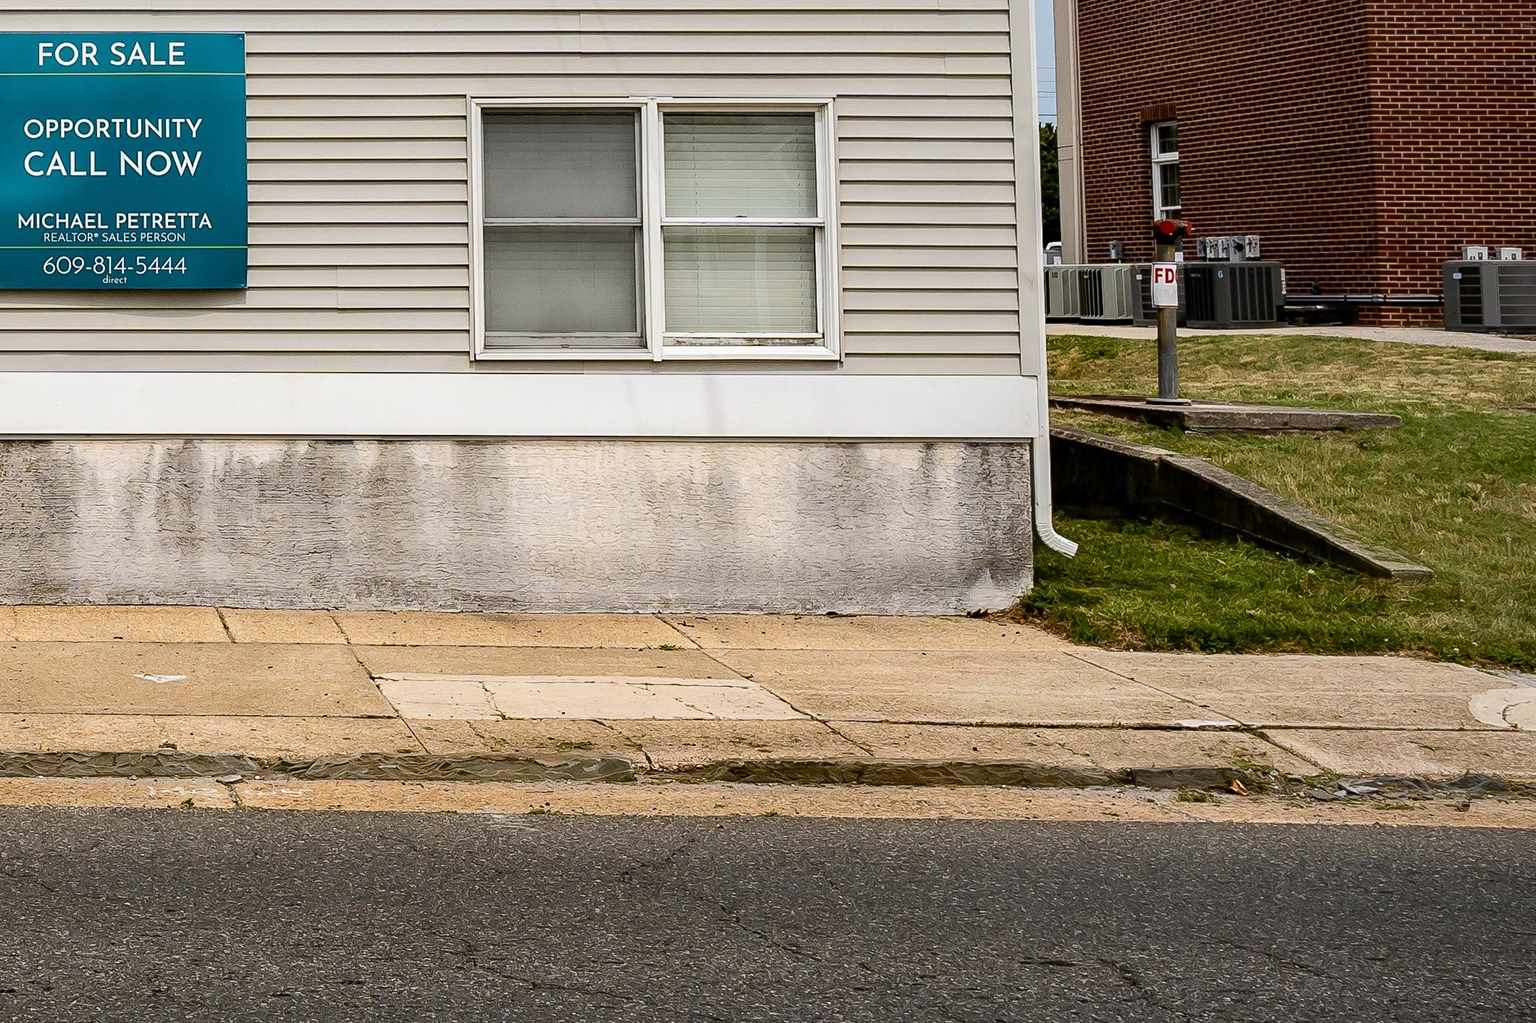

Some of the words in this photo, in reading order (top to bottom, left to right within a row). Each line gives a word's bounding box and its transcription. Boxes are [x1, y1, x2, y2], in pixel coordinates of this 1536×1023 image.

[38, 42, 99, 66] FOR
[109, 41, 186, 66] SALE
[23, 118, 203, 139] OPPORTUNITY
[24, 150, 107, 176] CALL
[120, 150, 203, 176] NOW
[17, 212, 109, 229] MICHAEL
[115, 212, 213, 229] PETRETTA
[101, 232, 137, 243] SALES
[140, 232, 187, 243] PERSON
[42, 255, 188, 275] 609-814-5444
[102, 275, 128, 285] direct
[1154, 267, 1178, 284] FD
